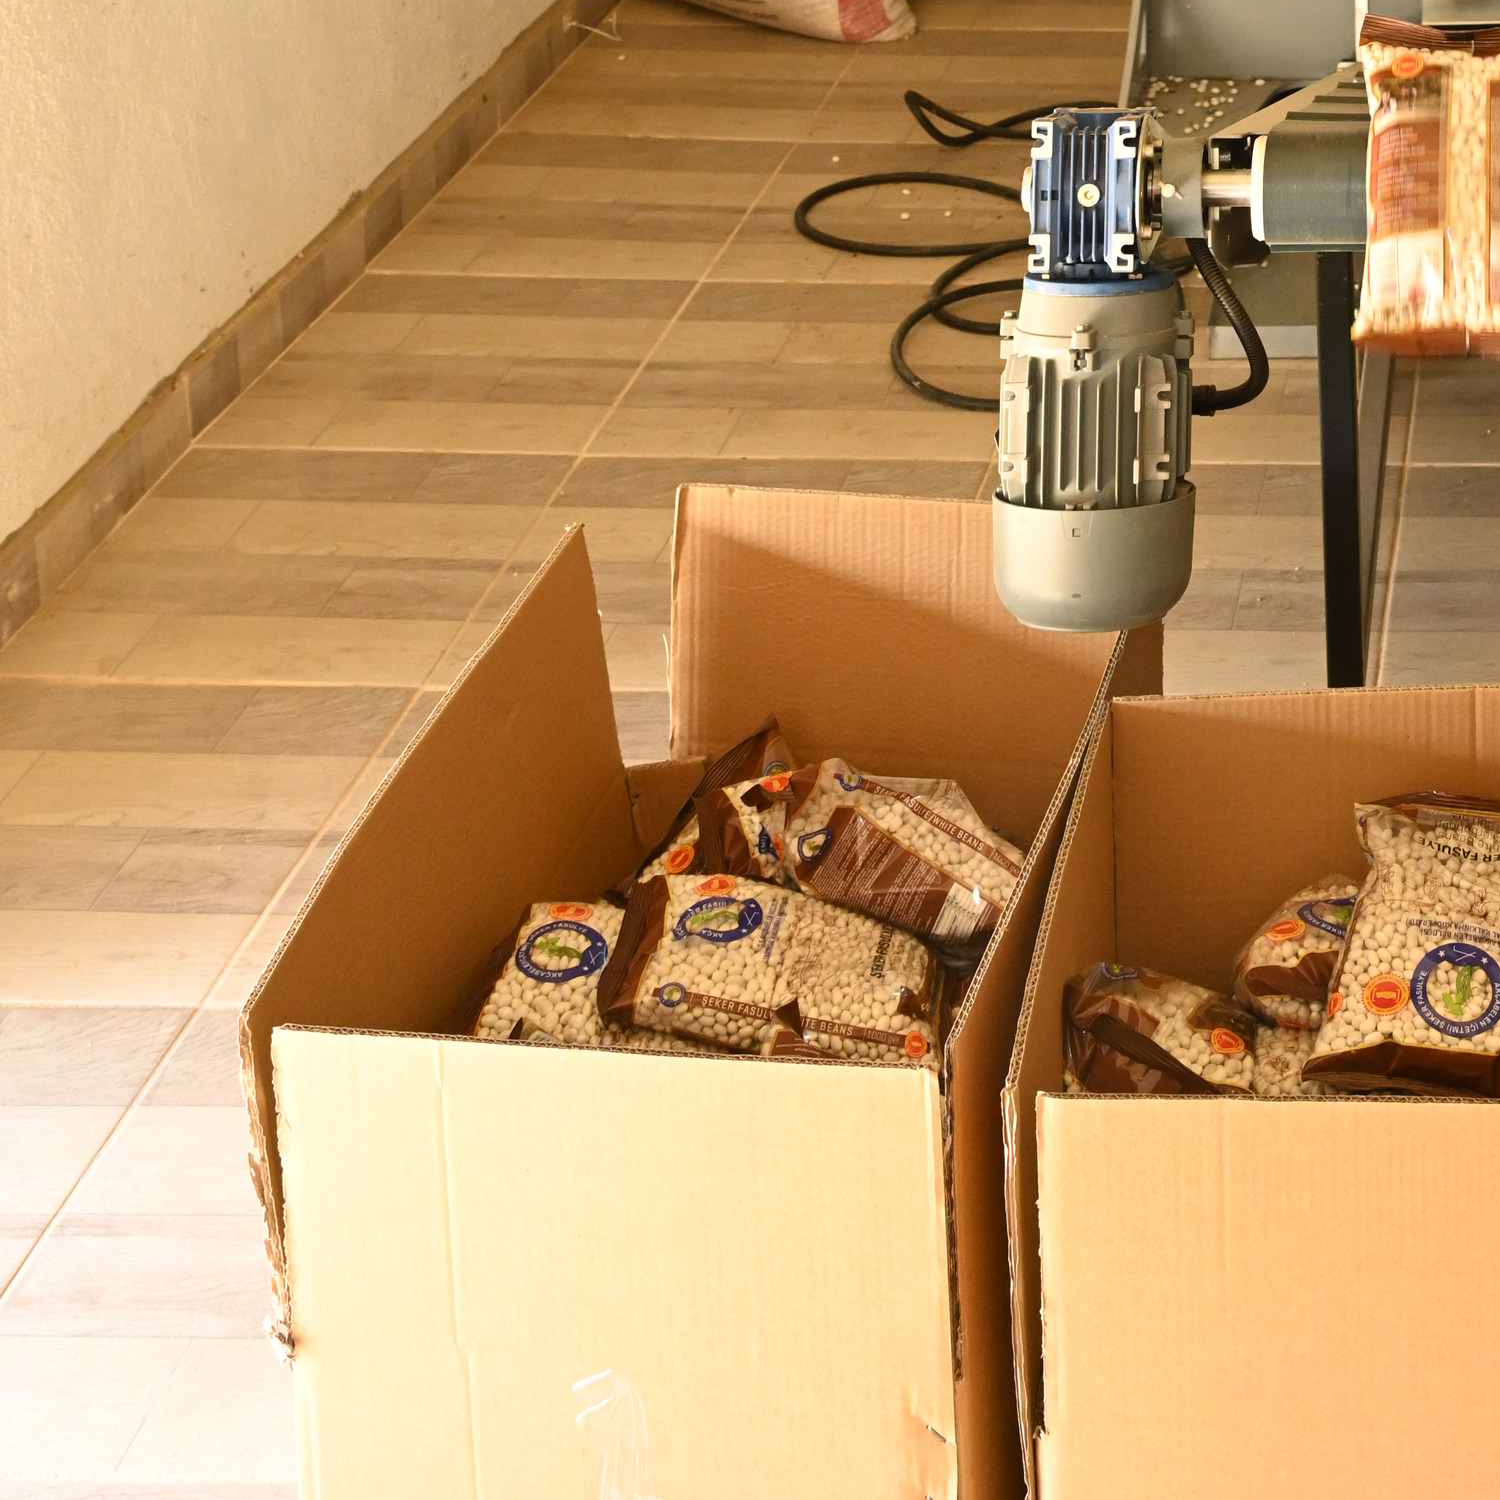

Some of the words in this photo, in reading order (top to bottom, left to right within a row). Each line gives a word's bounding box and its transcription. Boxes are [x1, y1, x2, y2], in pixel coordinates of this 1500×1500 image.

[956, 829, 985, 851] BEANS
[1417, 836, 1478, 862] FASULYE
[1414, 969, 1428, 1006] FASULYE
[701, 995, 735, 1014] ŞEKER
[819, 1020, 854, 1036] BEANS
[1421, 1004, 1446, 1029] ŞEKER
[1446, 1021, 1478, 1035] (ÇETMİ)
[867, 1029, 886, 1042] 1000
